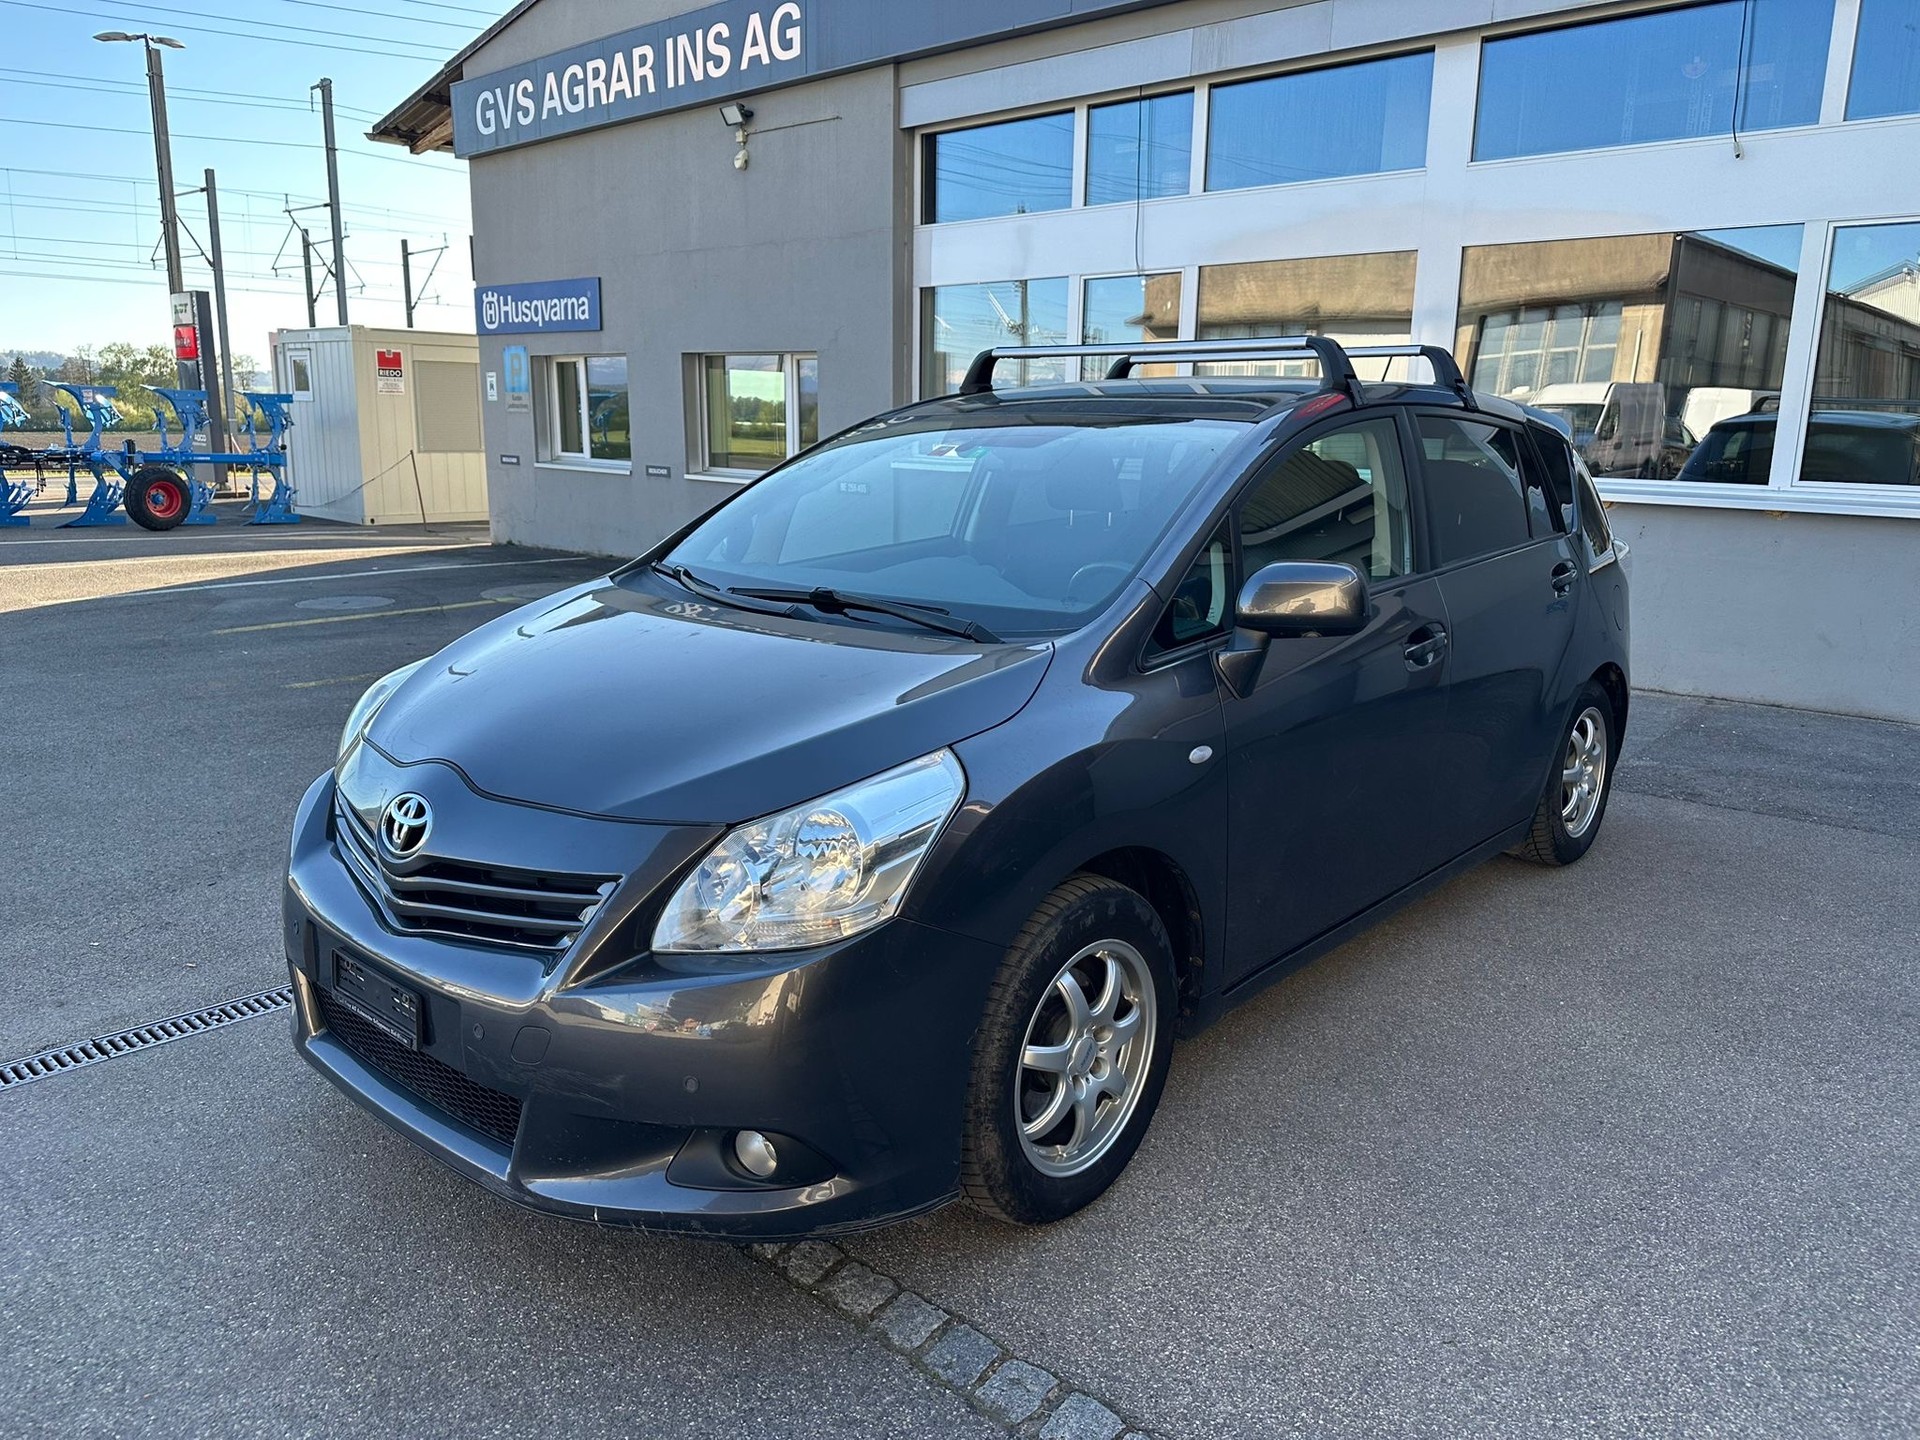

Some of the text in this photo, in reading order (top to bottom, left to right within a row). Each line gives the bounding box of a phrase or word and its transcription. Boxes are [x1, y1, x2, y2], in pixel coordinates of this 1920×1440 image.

[475, 2, 802, 136] GVS AGRAR INS AG
[500, 295, 589, 327] Husqvarna
[379, 369, 402, 377] RIEDO
